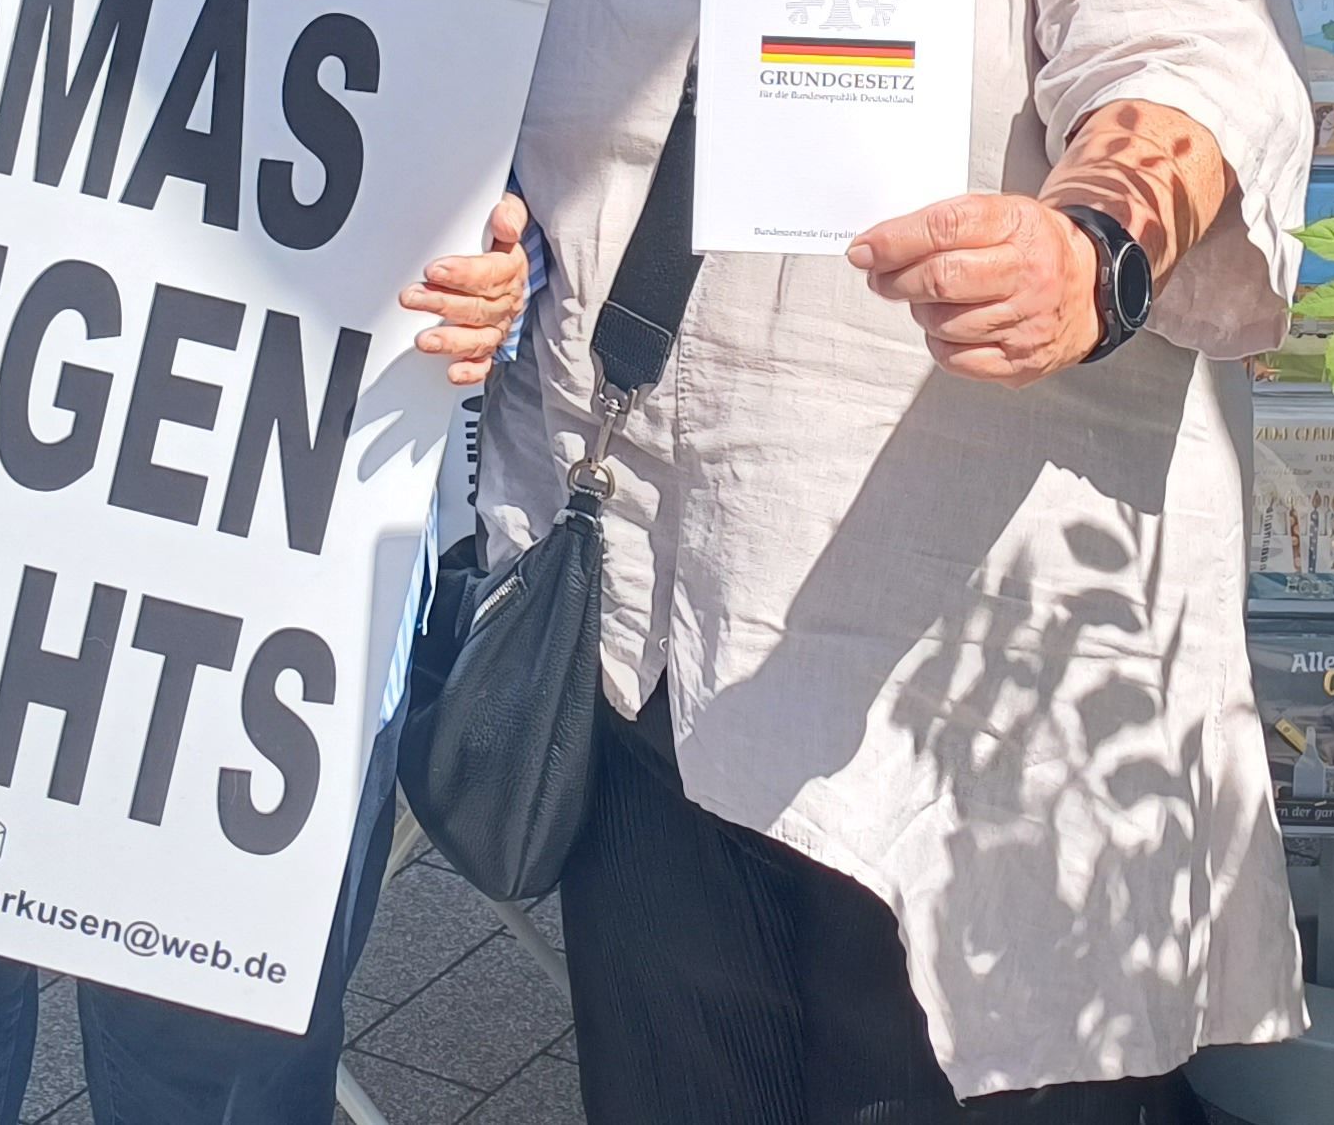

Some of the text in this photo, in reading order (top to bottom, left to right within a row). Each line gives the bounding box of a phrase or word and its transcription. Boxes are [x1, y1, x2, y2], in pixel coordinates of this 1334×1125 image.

[759, 69, 915, 91] GRUNDGESETZ
[860, 93, 915, 104] Deutschland
[1291, 806, 1311, 818] der
